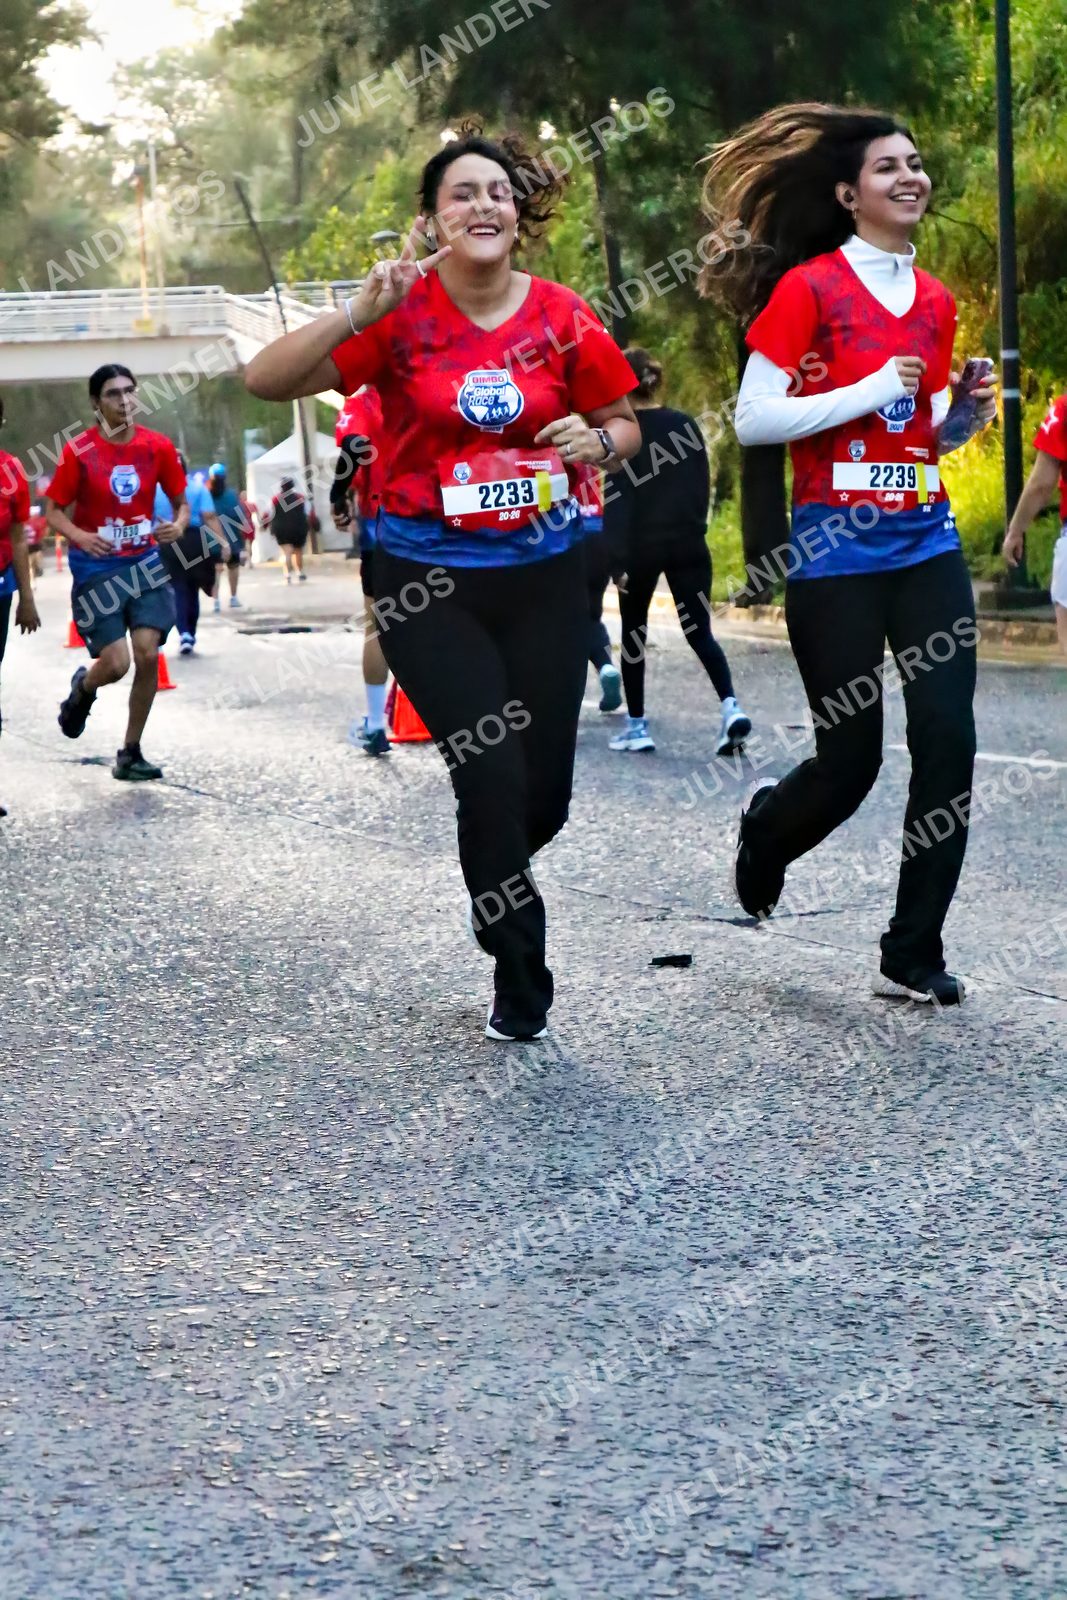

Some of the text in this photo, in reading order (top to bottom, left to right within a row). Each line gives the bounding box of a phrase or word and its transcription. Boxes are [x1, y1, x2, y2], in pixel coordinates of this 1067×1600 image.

[472, 376, 505, 384] BIMBO
[473, 386, 506, 396] Global
[468, 395, 495, 406] Race
[870, 465, 917, 488] 2239
[478, 479, 535, 509] 2233
